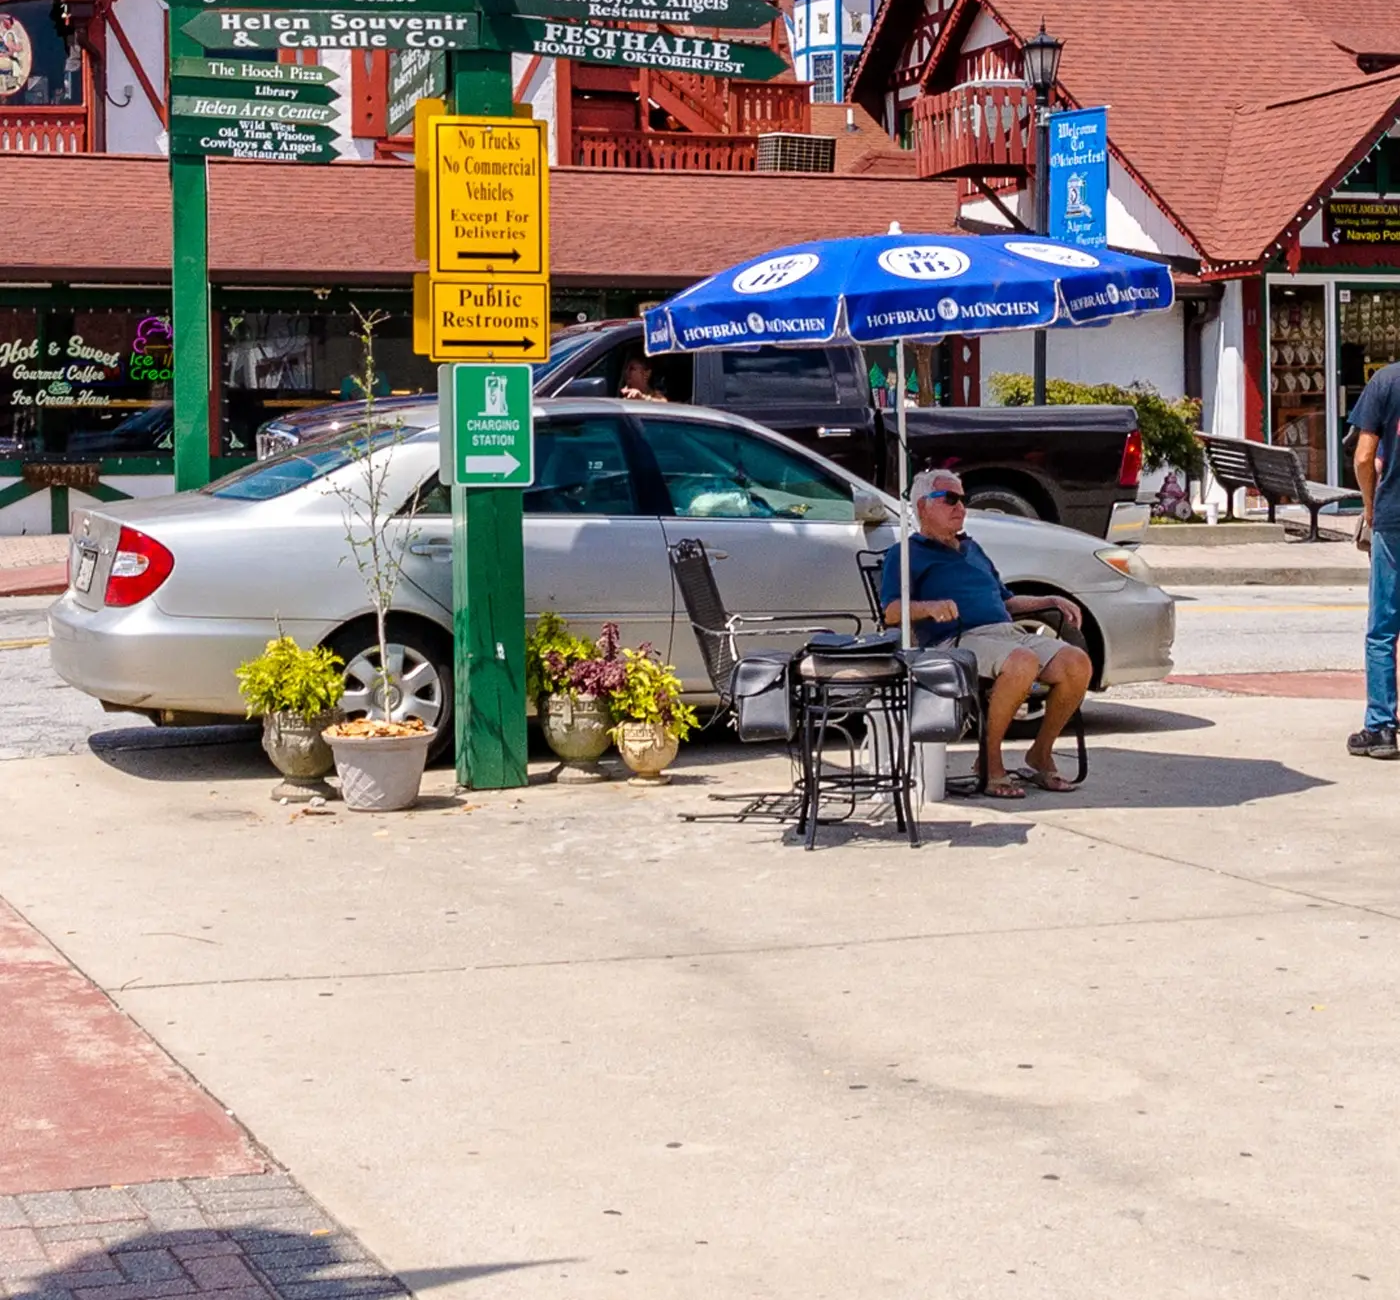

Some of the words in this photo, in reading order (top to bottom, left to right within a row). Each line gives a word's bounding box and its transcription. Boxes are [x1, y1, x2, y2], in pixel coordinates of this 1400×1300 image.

[221, 13, 311, 31] Helen
[330, 12, 468, 31] Souvenir
[588, 3, 690, 22] Restaurant
[233, 31, 259, 48] &
[278, 30, 387, 48] Candle
[405, 31, 456, 48] Co.
[543, 22, 731, 61] FESTHALLE
[533, 39, 586, 58] HOME
[593, 46, 616, 60] OF
[623, 50, 744, 74] OKTOBERFEST
[208, 61, 235, 76] The
[241, 64, 283, 79] Hooch
[290, 67, 323, 81] Pizza
[255, 85, 299, 100] Library
[193, 100, 237, 116] Helen
[240, 102, 275, 117] Arts
[278, 104, 329, 121] Center
[218, 127, 239, 138] Old
[243, 129, 272, 140] Time
[277, 130, 316, 142] Photos
[239, 120, 266, 131] Wild
[271, 122, 296, 132] West
[1058, 122, 1098, 139] Welcome
[200, 137, 258, 152] Cowboys
[263, 141, 274, 151] &
[280, 142, 323, 154] Angels
[458, 130, 476, 150] No
[480, 130, 520, 150] Trucks
[1071, 138, 1084, 151] To
[233, 148, 298, 161] Restaurant
[1050, 149, 1105, 168] Oktoberfest
[443, 155, 460, 175] No
[464, 155, 536, 177] Commercial
[466, 181, 515, 202] Vehicles
[451, 208, 498, 224] Except
[506, 210, 530, 223] For
[1330, 204, 1358, 214] NATIVE
[1360, 204, 1398, 214] AMERICAN
[454, 225, 526, 240] Deliveries
[1347, 229, 1381, 243] Navajo
[459, 288, 522, 308] Public
[442, 310, 540, 329] Restrooms
[866, 306, 936, 328] HOFBRÄU
[961, 300, 1039, 318] MÜNCHEN
[683, 320, 748, 341] HOFBRÄU
[764, 317, 825, 333] MÜNCHEN
[0, 338, 39, 367] Hot
[48, 341, 61, 356] &
[67, 335, 120, 368] Sweet
[129, 352, 154, 367] Ice
[12, 364, 66, 381] Gourmet
[66, 364, 105, 383] Coffee
[130, 367, 174, 381] Crea
[11, 389, 33, 406] Ice
[35, 390, 75, 406] Cream
[77, 389, 111, 406] Haus
[467, 419, 520, 432] CHARGING
[472, 434, 515, 447] STATION
